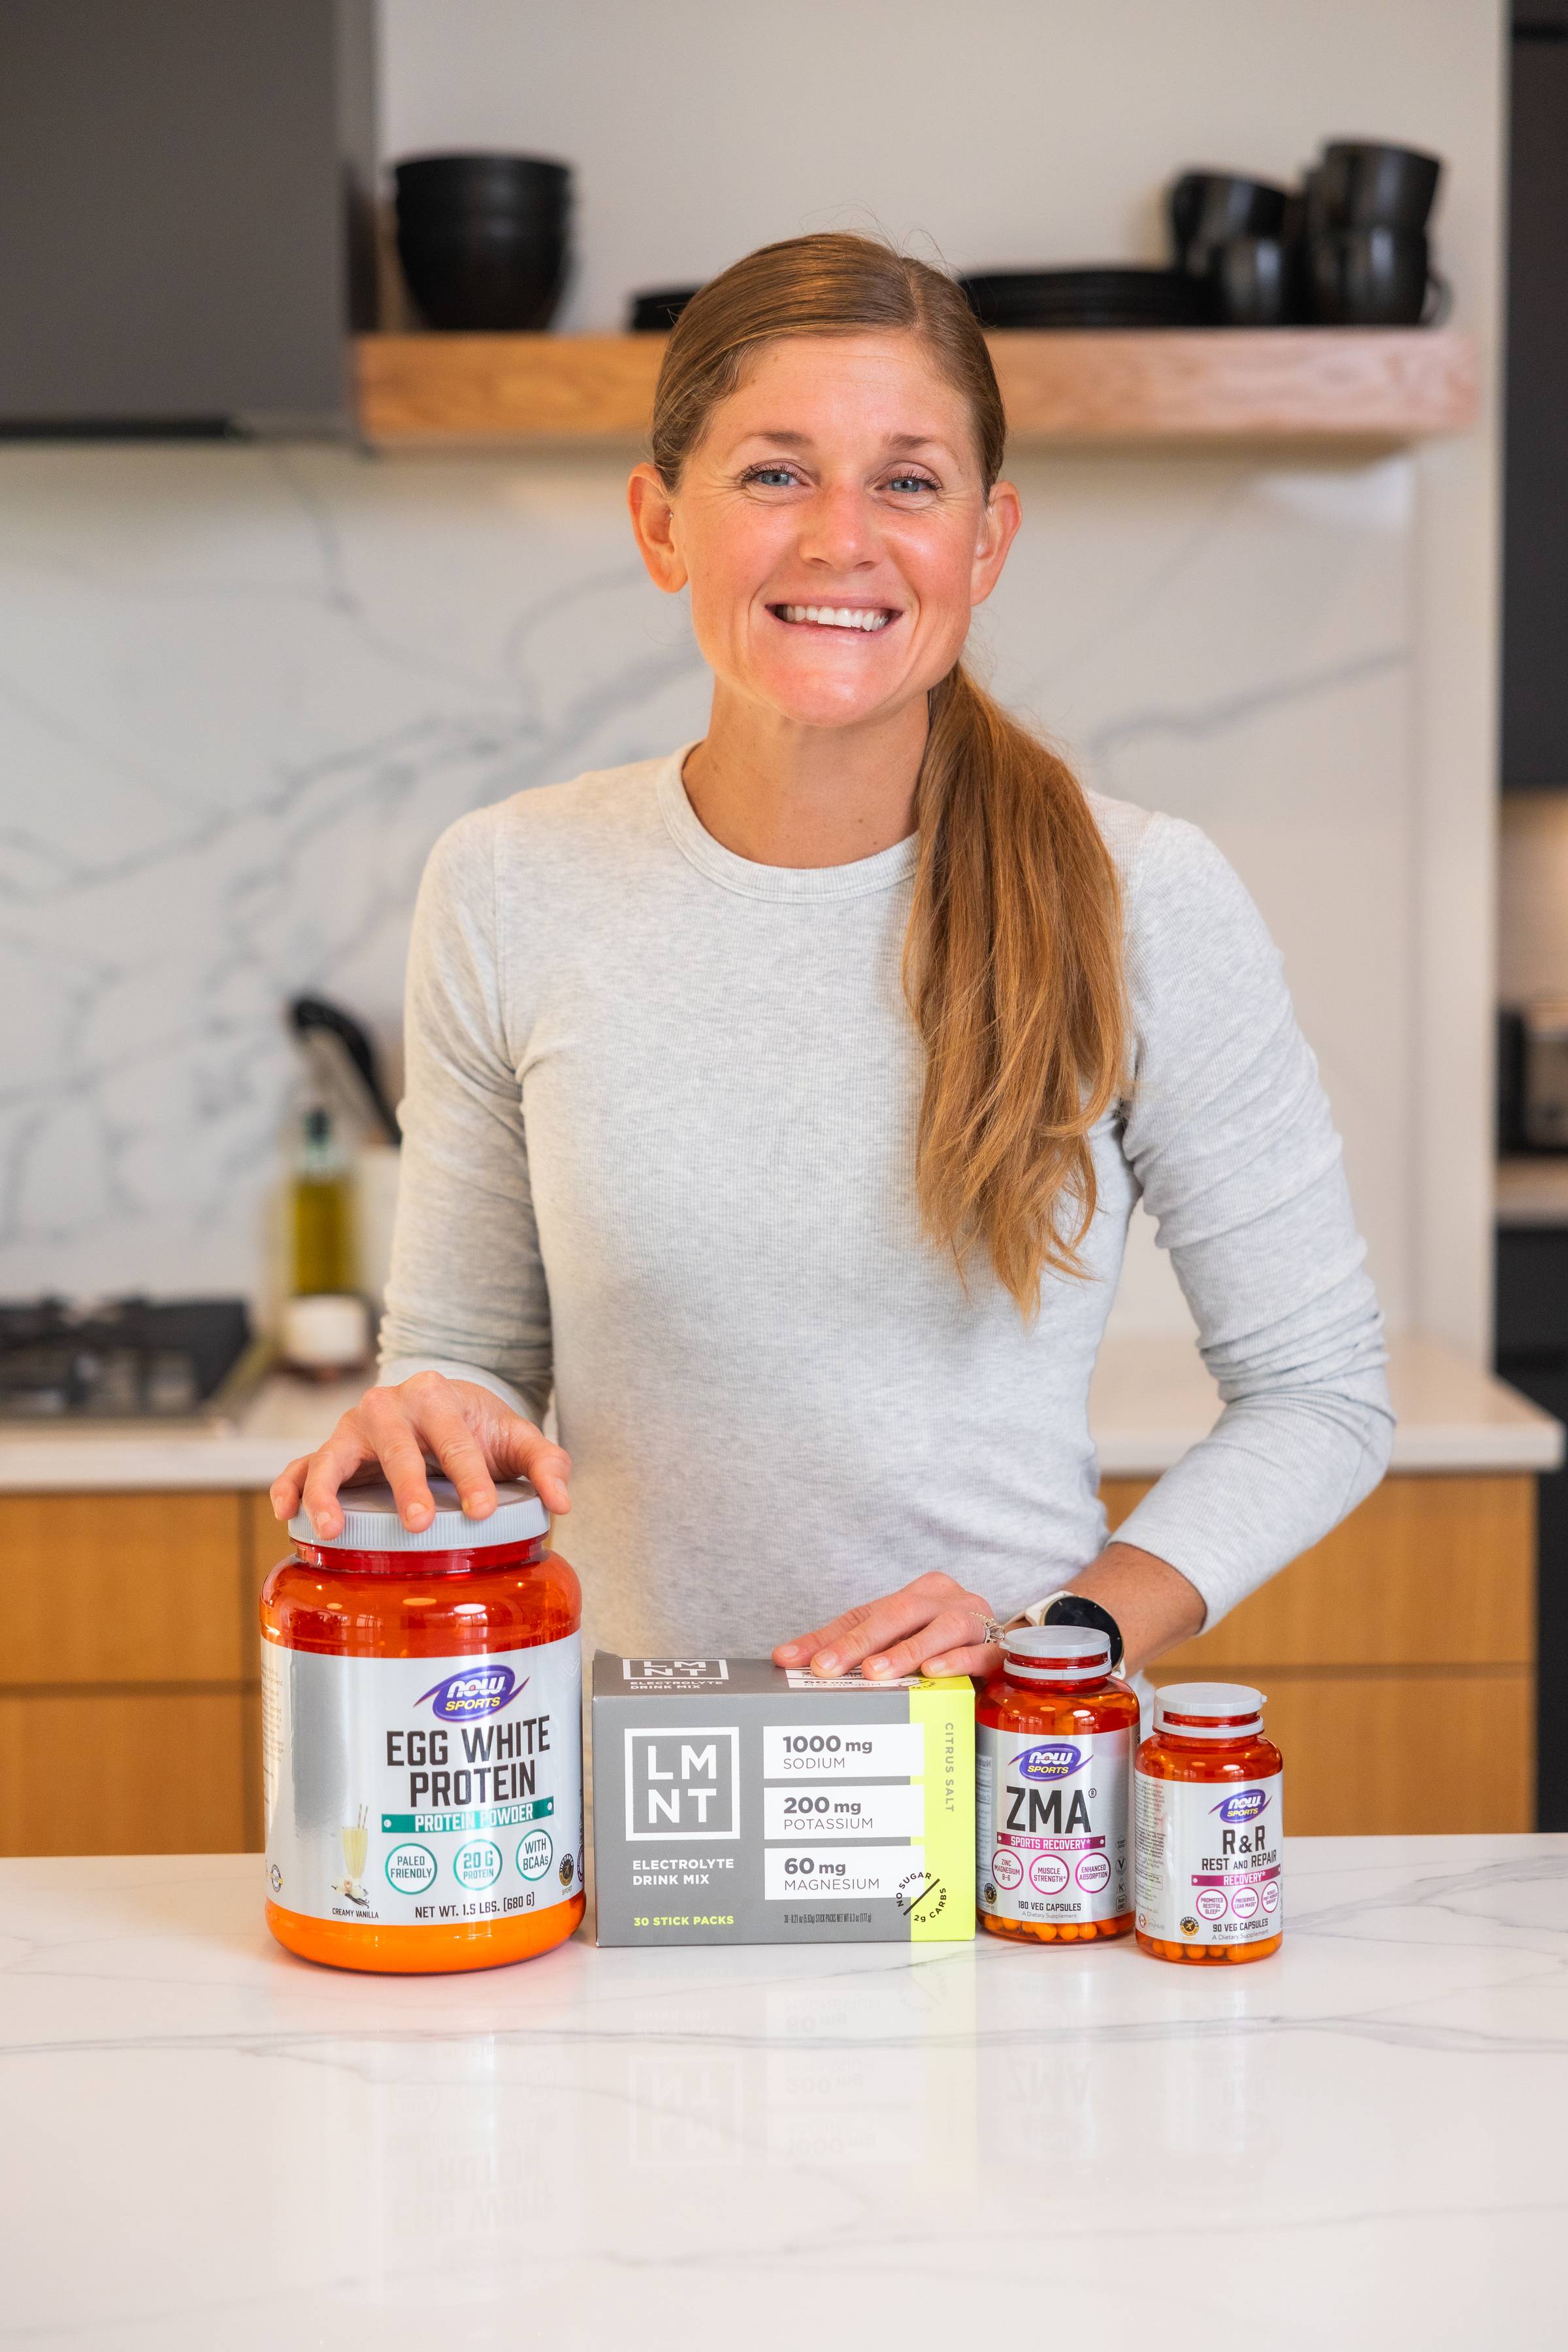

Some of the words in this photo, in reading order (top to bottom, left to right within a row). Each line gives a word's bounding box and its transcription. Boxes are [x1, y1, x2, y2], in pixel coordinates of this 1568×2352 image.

[445, 1697, 501, 1711] SPORTS
[387, 1730, 448, 1766] EGG
[461, 1715, 550, 1763] WHITE
[783, 1735, 841, 1753] 1000
[845, 1740, 873, 1755] mg
[945, 1722, 955, 1773] CITRUS
[783, 1757, 845, 1769] SODIUM
[1027, 1765, 1070, 1774] SPORTS
[410, 1759, 535, 1807] PROTEIN
[945, 1778, 955, 1812] SALT
[784, 1797, 829, 1814] 200
[834, 1801, 861, 1816] mg
[1227, 1808, 1258, 1817] SPORTS
[415, 1812, 475, 1832] PROTEIN
[480, 1803, 533, 1827] POWDER
[784, 1818, 874, 1831] POTASSIUM
[525, 1838, 546, 1855] WITH
[1011, 1835, 1040, 1850] SPORTS
[397, 1855, 425, 1866] PALEO
[463, 1852, 482, 1869] 20
[485, 1850, 493, 1867] G
[523, 1854, 548, 1871] BCAAs
[632, 1858, 734, 1870] ELECTROLYTE
[1202, 1858, 1230, 1870] REST
[1233, 1860, 1248, 1870] AND
[1251, 1850, 1277, 1868] REPAIR
[391, 1868, 433, 1878] FRIENDLY
[463, 1868, 494, 1880] PROTEIN
[784, 1857, 815, 1876] 60
[819, 1863, 846, 1877] mg
[994, 1864, 1020, 1876] MAGNESIUM
[1081, 1864, 1106, 1873] ENHANCED
[632, 1874, 679, 1886] DRINK
[683, 1873, 710, 1886] MIX
[899, 1872, 932, 1889] SUGAR
[1079, 1871, 1108, 1880] ABSORPTION
[784, 1878, 880, 1891] MAGNESIUM
[896, 1892, 904, 1907] NO
[913, 1914, 926, 1923] 2g
[929, 1887, 947, 1918] CARBS
[1018, 1900, 1028, 1910] 180
[1030, 1902, 1043, 1911] VEG
[1046, 1903, 1081, 1912] CAPSULES
[332, 1908, 354, 1917] CREAMY
[356, 1910, 379, 1919] VANILLA
[416, 1906, 435, 1918] NET
[440, 1904, 459, 1917] WT.
[463, 1903, 476, 1916] 1.5
[479, 1901, 500, 1915] LBS.
[633, 1916, 649, 1927] 30
[653, 1916, 690, 1926] STICK
[693, 1915, 734, 1925] PACKS
[815, 1913, 825, 1923] STICK
[825, 1913, 836, 1923] PACKS
[1213, 1924, 1222, 1933] 90
[1224, 1922, 1237, 1932] VEG
[1239, 1918, 1269, 1931] CAPSULES
[1218, 1933, 1239, 1941] Dietary
[1241, 1929, 1269, 1939] Supplement
